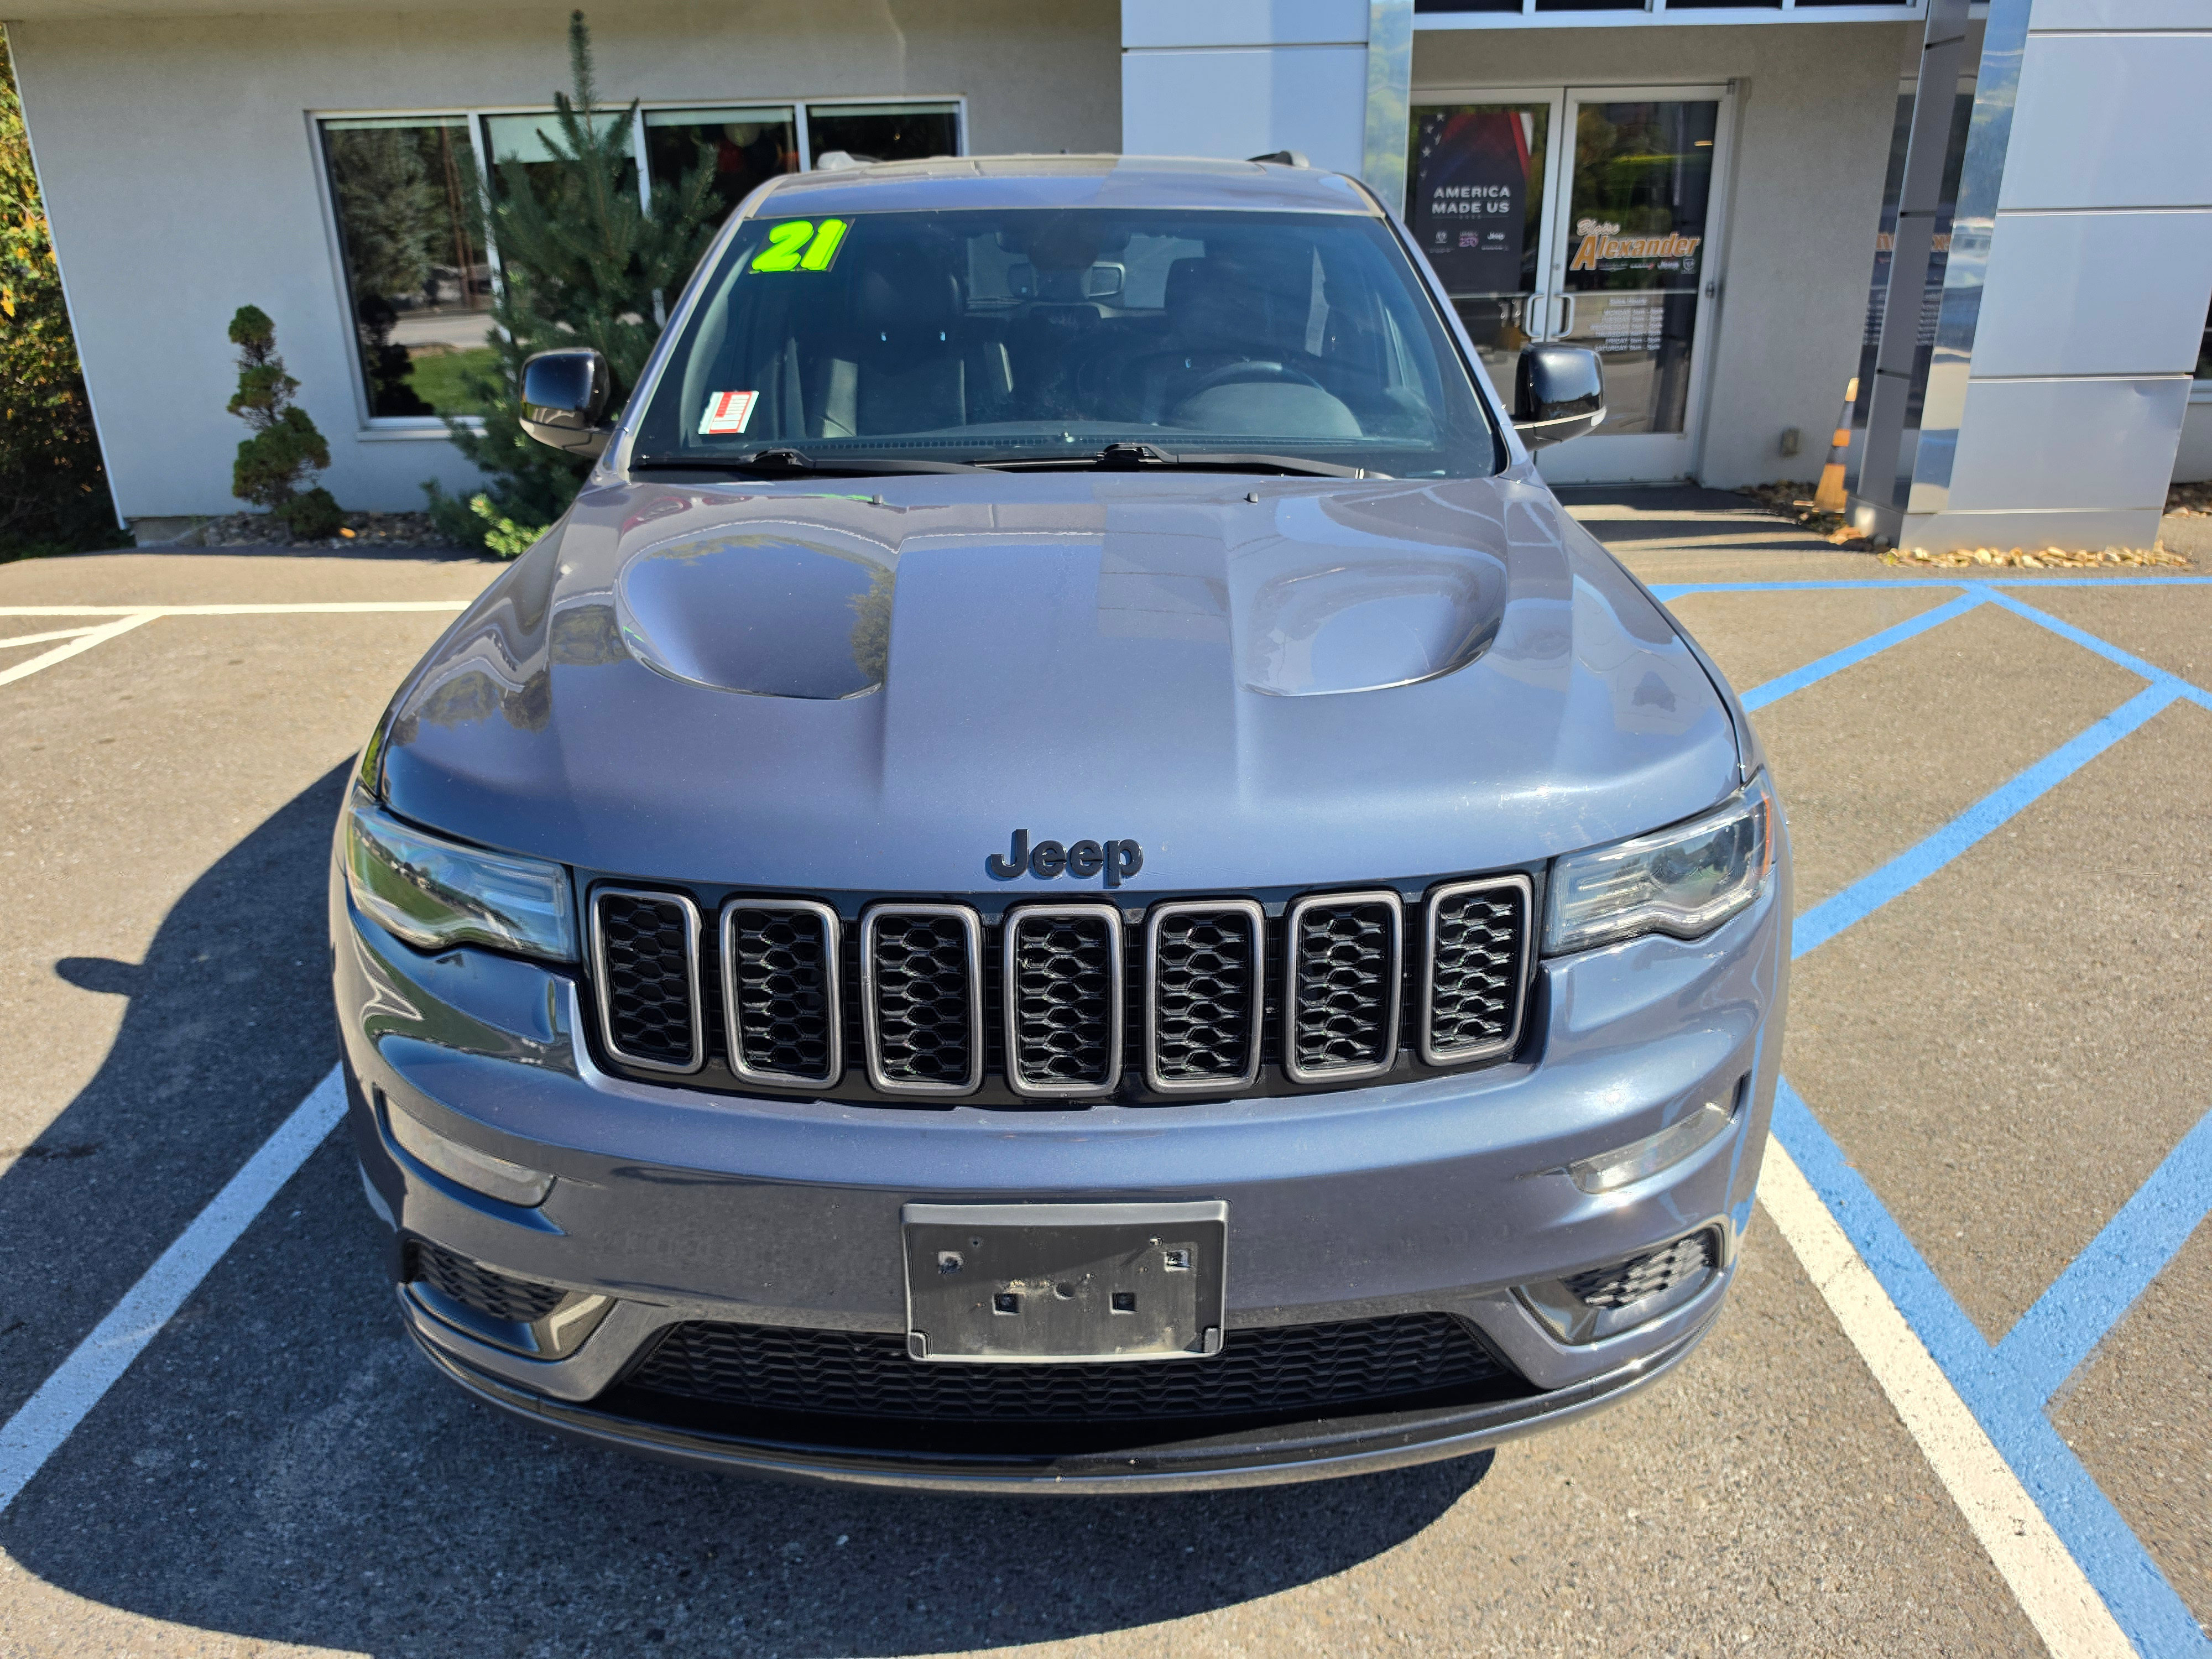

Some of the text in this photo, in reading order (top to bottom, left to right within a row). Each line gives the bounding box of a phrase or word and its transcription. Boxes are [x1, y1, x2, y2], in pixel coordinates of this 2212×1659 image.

[1432, 200, 1510, 213] MADE US
[1433, 185, 1510, 198] AMERICA
[752, 219, 847, 272] 21
[1569, 231, 1701, 270] Alexander
[990, 828, 1144, 886] Jeep
